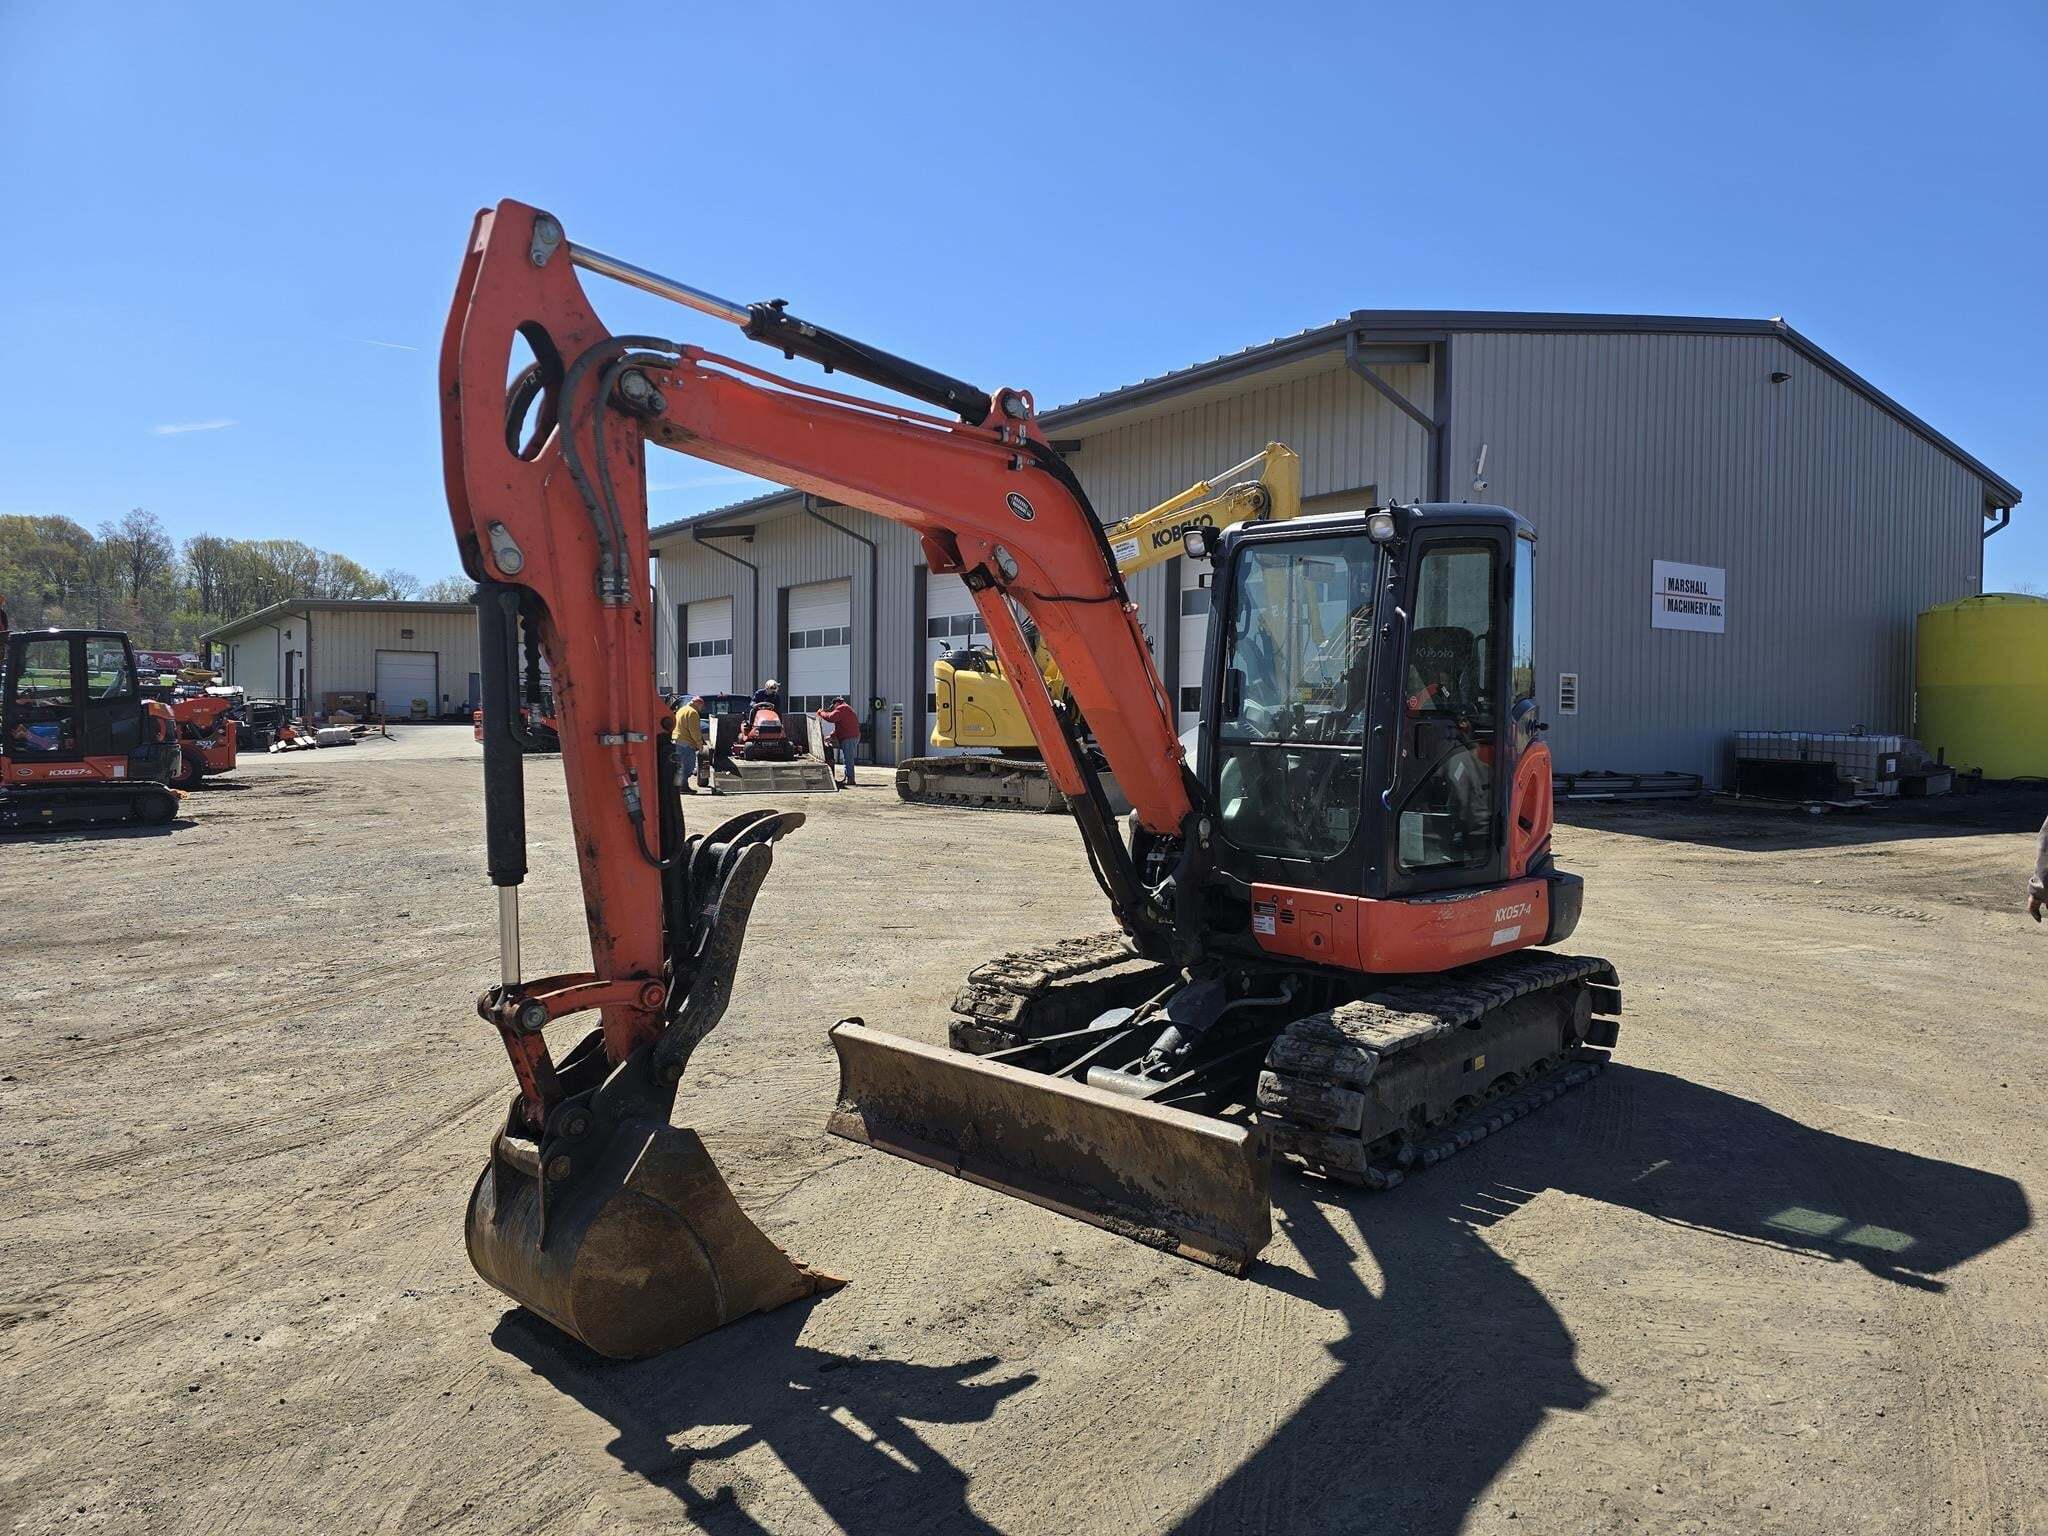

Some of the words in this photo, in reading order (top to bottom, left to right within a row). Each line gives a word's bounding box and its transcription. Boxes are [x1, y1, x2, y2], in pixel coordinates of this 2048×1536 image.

[1151, 513, 1213, 549] KOBO
[1668, 577, 1708, 595] MARSHALL
[1416, 647, 1454, 658] Kubota
[1494, 903, 1532, 923] KX057-4
